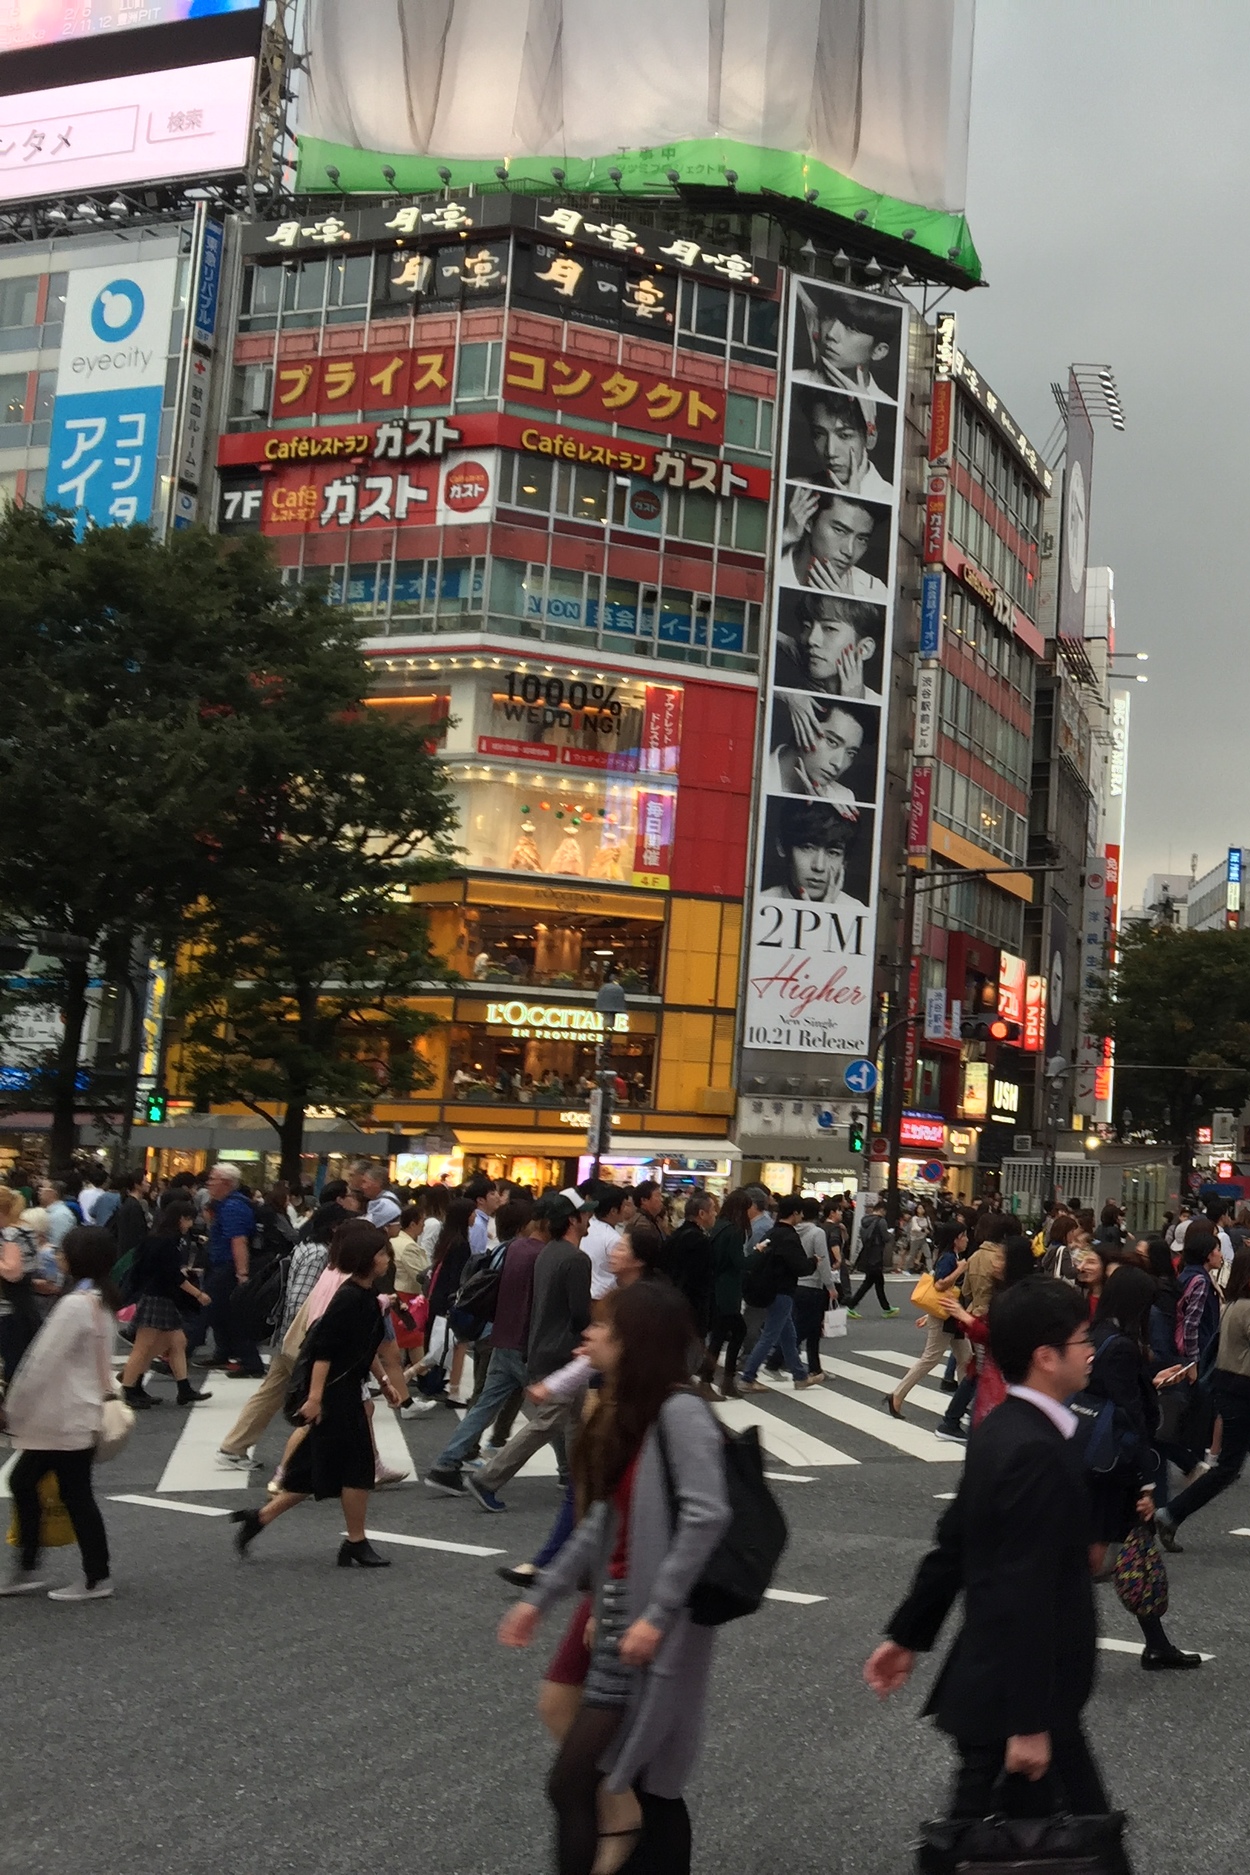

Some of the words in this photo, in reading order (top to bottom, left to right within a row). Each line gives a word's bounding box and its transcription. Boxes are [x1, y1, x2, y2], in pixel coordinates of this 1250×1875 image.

[168, 108, 204, 134] 検索
[617, 147, 676, 160] 工事中
[266, 218, 345, 247] 月の宴
[385, 202, 467, 232] 月の宴
[539, 208, 638, 250] 月の宴
[536, 244, 555, 256] 9F
[658, 240, 754, 282] 月の宴
[391, 249, 500, 296] 月の宴
[534, 257, 666, 318] 月の宴
[72, 348, 154, 378] eyecity
[279, 354, 449, 404] プライス
[507, 351, 719, 428] コンタクト
[374, 417, 460, 459] ガスト
[653, 450, 748, 497] ガスト
[224, 490, 262, 519] 7F
[272, 484, 317, 508] Café
[321, 474, 429, 526] ガスト
[450, 483, 484, 499] ガスト
[929, 513, 942, 553] ガスト
[505, 671, 623, 717] 1000%
[504, 702, 622, 736] WEDDING!
[918, 676, 932, 748] 渋谷駅前ビル
[1113, 698, 1126, 727] BIC
[914, 768, 931, 778] 5F
[1110, 728, 1125, 797] CAMERA
[640, 875, 660, 887] 4F
[756, 905, 869, 956] 2PM
[750, 954, 867, 1018] Higher
[512, 1027, 530, 1038] EN
[535, 1029, 604, 1043] PROVENCE
[749, 1026, 792, 1045] 10.21
[799, 1029, 865, 1051] Release
[803, 1017, 838, 1030] Single
